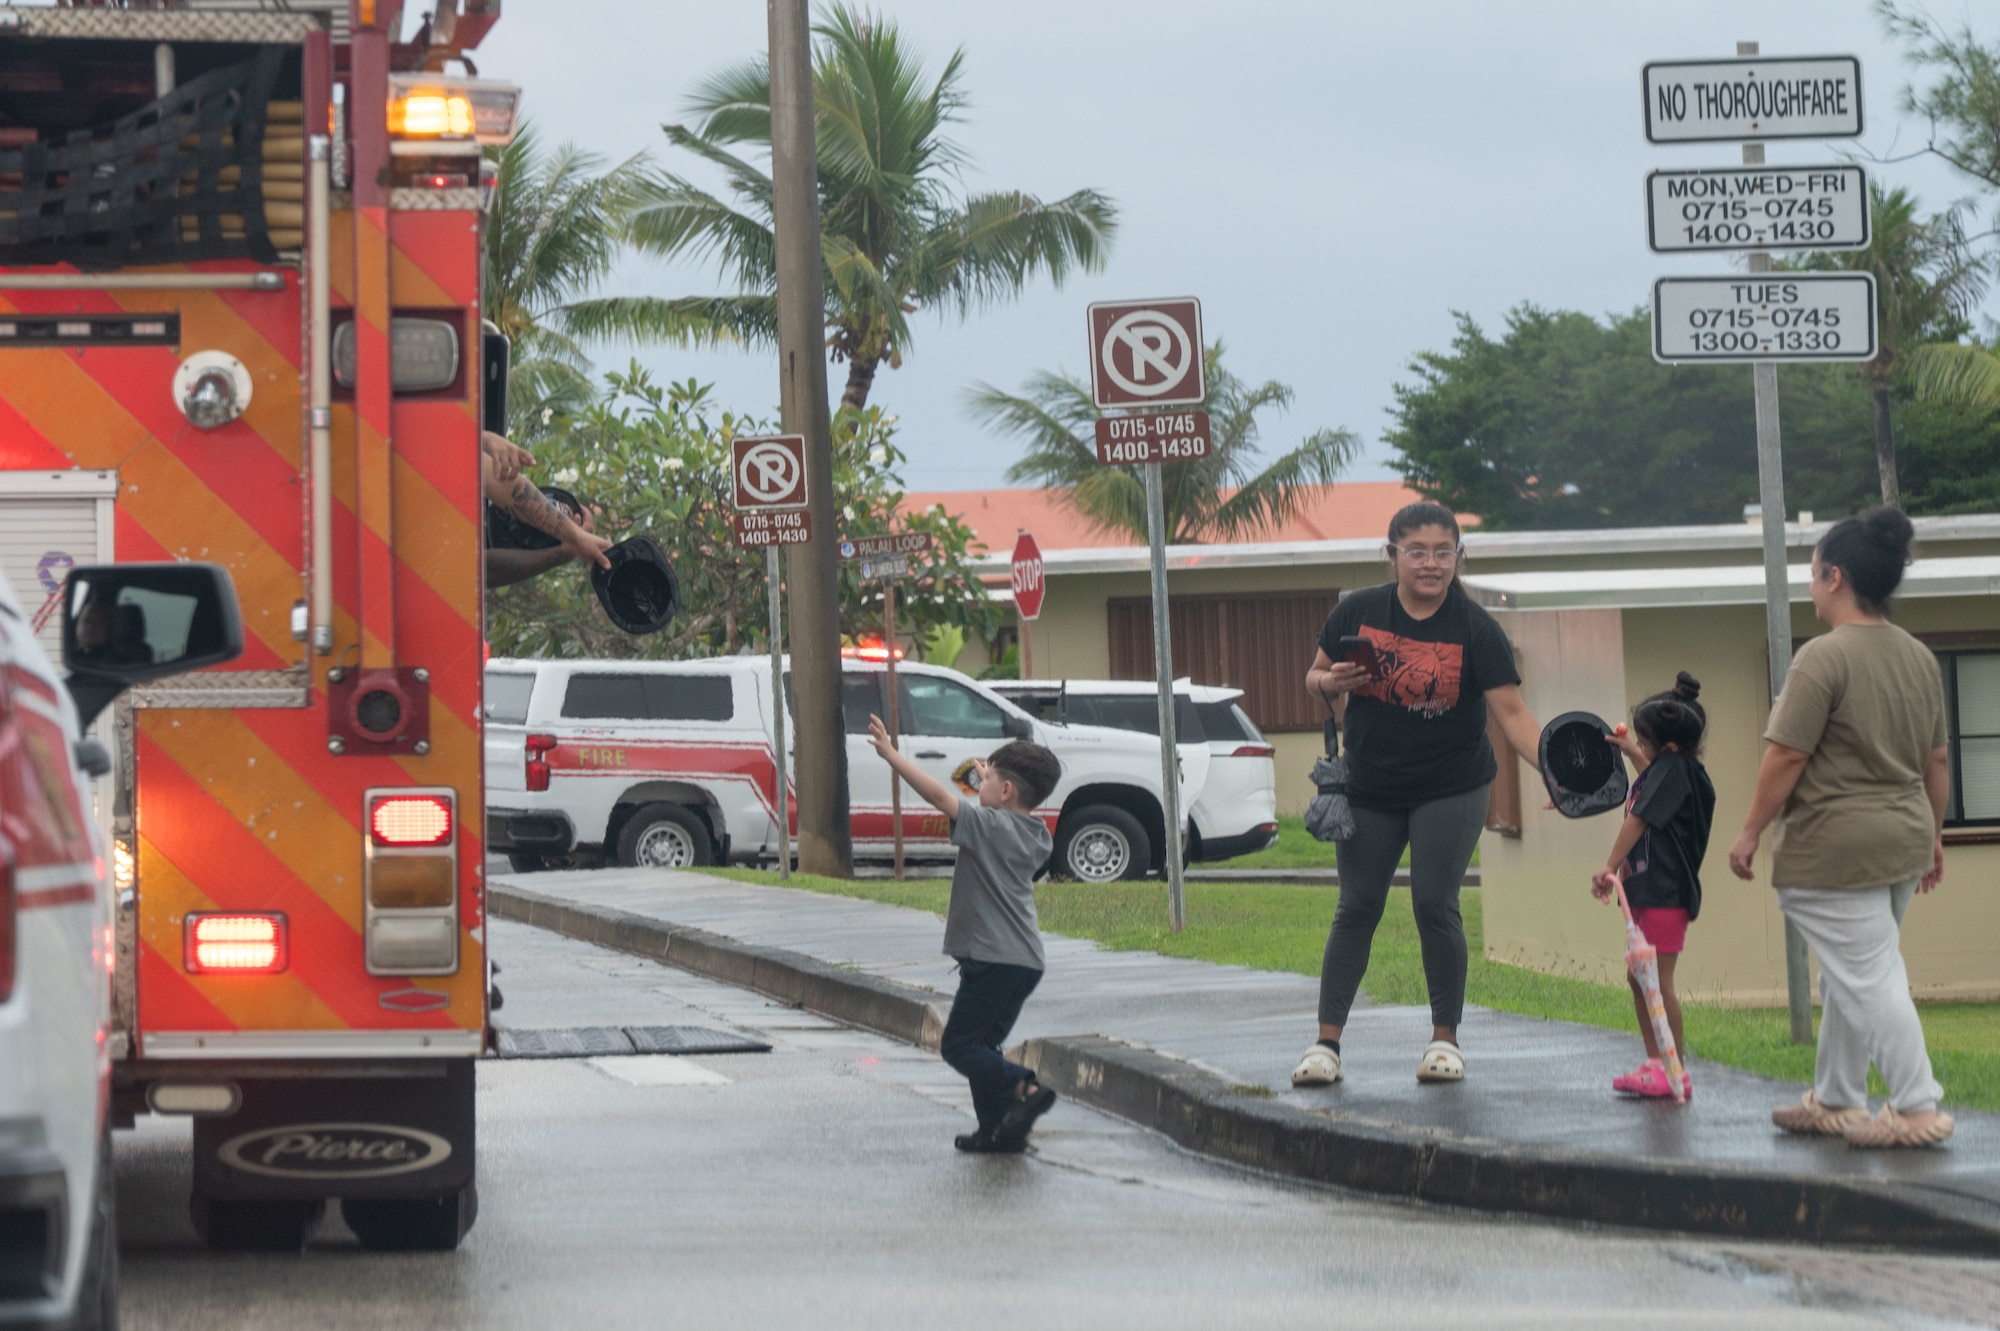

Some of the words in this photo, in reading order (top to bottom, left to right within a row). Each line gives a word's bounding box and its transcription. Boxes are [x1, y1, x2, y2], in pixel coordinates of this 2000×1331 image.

[1658, 84, 1686, 121] NO
[1693, 78, 1848, 119] THOROUGHFARE
[1667, 174, 1846, 199] MON,WED-FRI
[1682, 198, 1834, 221] 0715-0745
[1683, 220, 1835, 244] 1400-1430
[1730, 284, 1799, 304] TUES
[1689, 308, 1840, 329] 0715-0745
[1690, 331, 1841, 351] 1300-1330
[1109, 414, 1195, 439] 0715-0745
[1104, 436, 1205, 463] 1400-1430
[739, 528, 807, 545] 1400-1430
[859, 539, 892, 556] PALAU
[895, 535, 926, 552] LOOP
[1013, 558, 1042, 594] STOP
[578, 748, 629, 768] FIRE
[921, 817, 950, 836] FIR
[261, 1132, 408, 1166] Pierce
